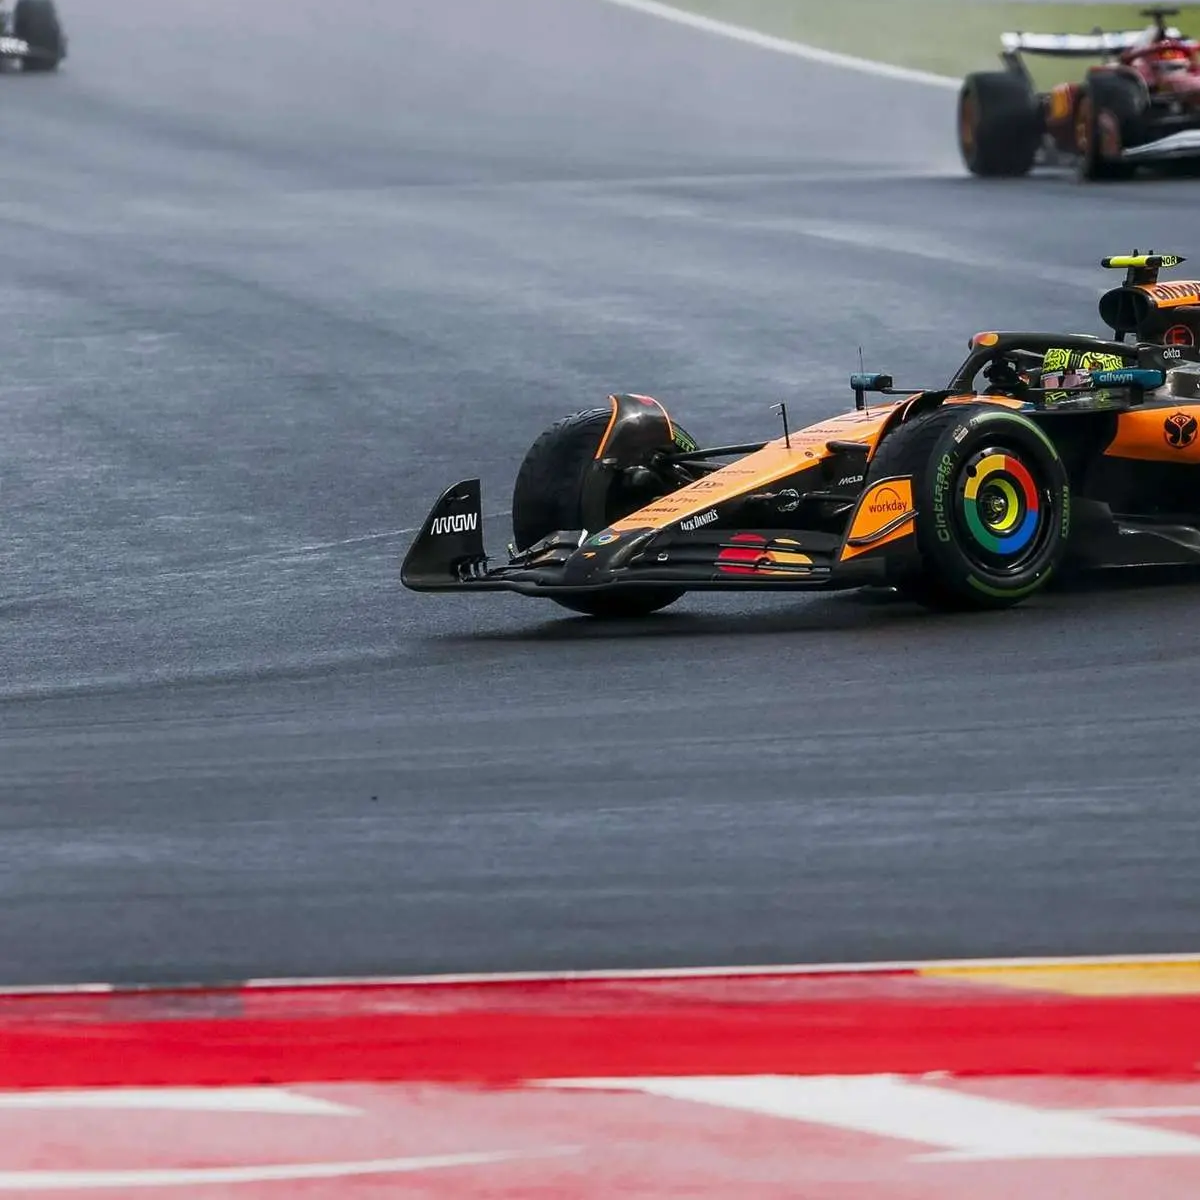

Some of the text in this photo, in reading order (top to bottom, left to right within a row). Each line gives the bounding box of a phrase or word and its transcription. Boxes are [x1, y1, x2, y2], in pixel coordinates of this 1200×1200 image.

[1160, 255, 1177, 267] NOR
[1163, 347, 1181, 359] okta
[1099, 370, 1133, 383] allwyn
[869, 499, 908, 513] workday
